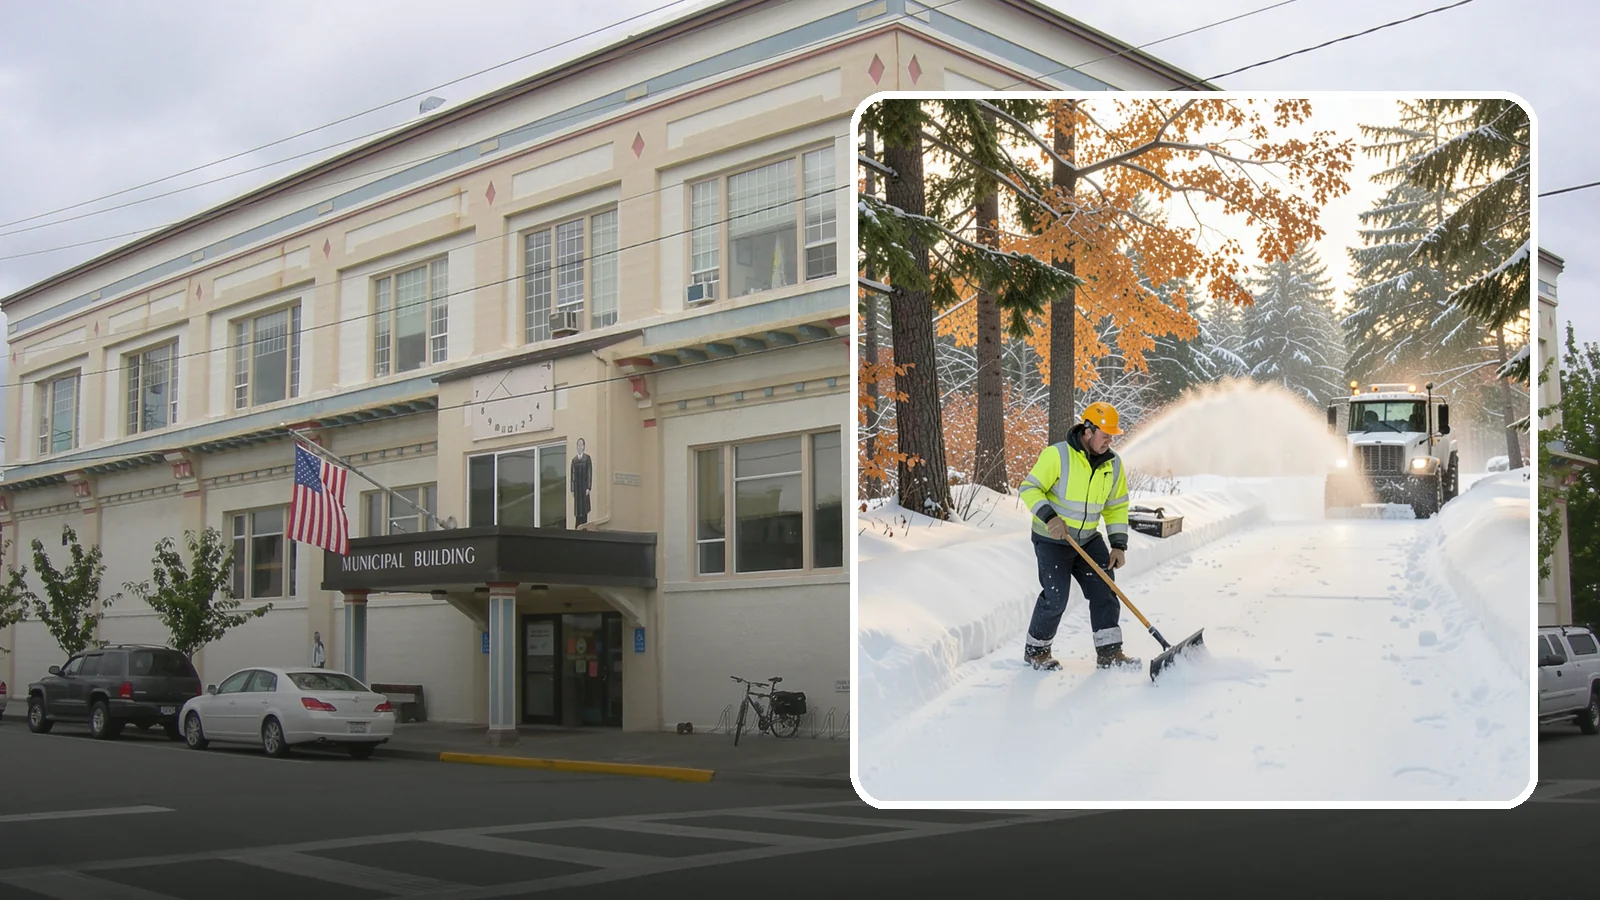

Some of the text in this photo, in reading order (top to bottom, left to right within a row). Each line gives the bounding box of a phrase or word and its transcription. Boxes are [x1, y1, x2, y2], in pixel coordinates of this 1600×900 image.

[481, 407, 485, 415] 8
[529, 414, 533, 422] 3
[495, 424, 500, 432] 10
[508, 426, 514, 434] 12
[342, 546, 475, 572] MUNICIPAL BUILDING
